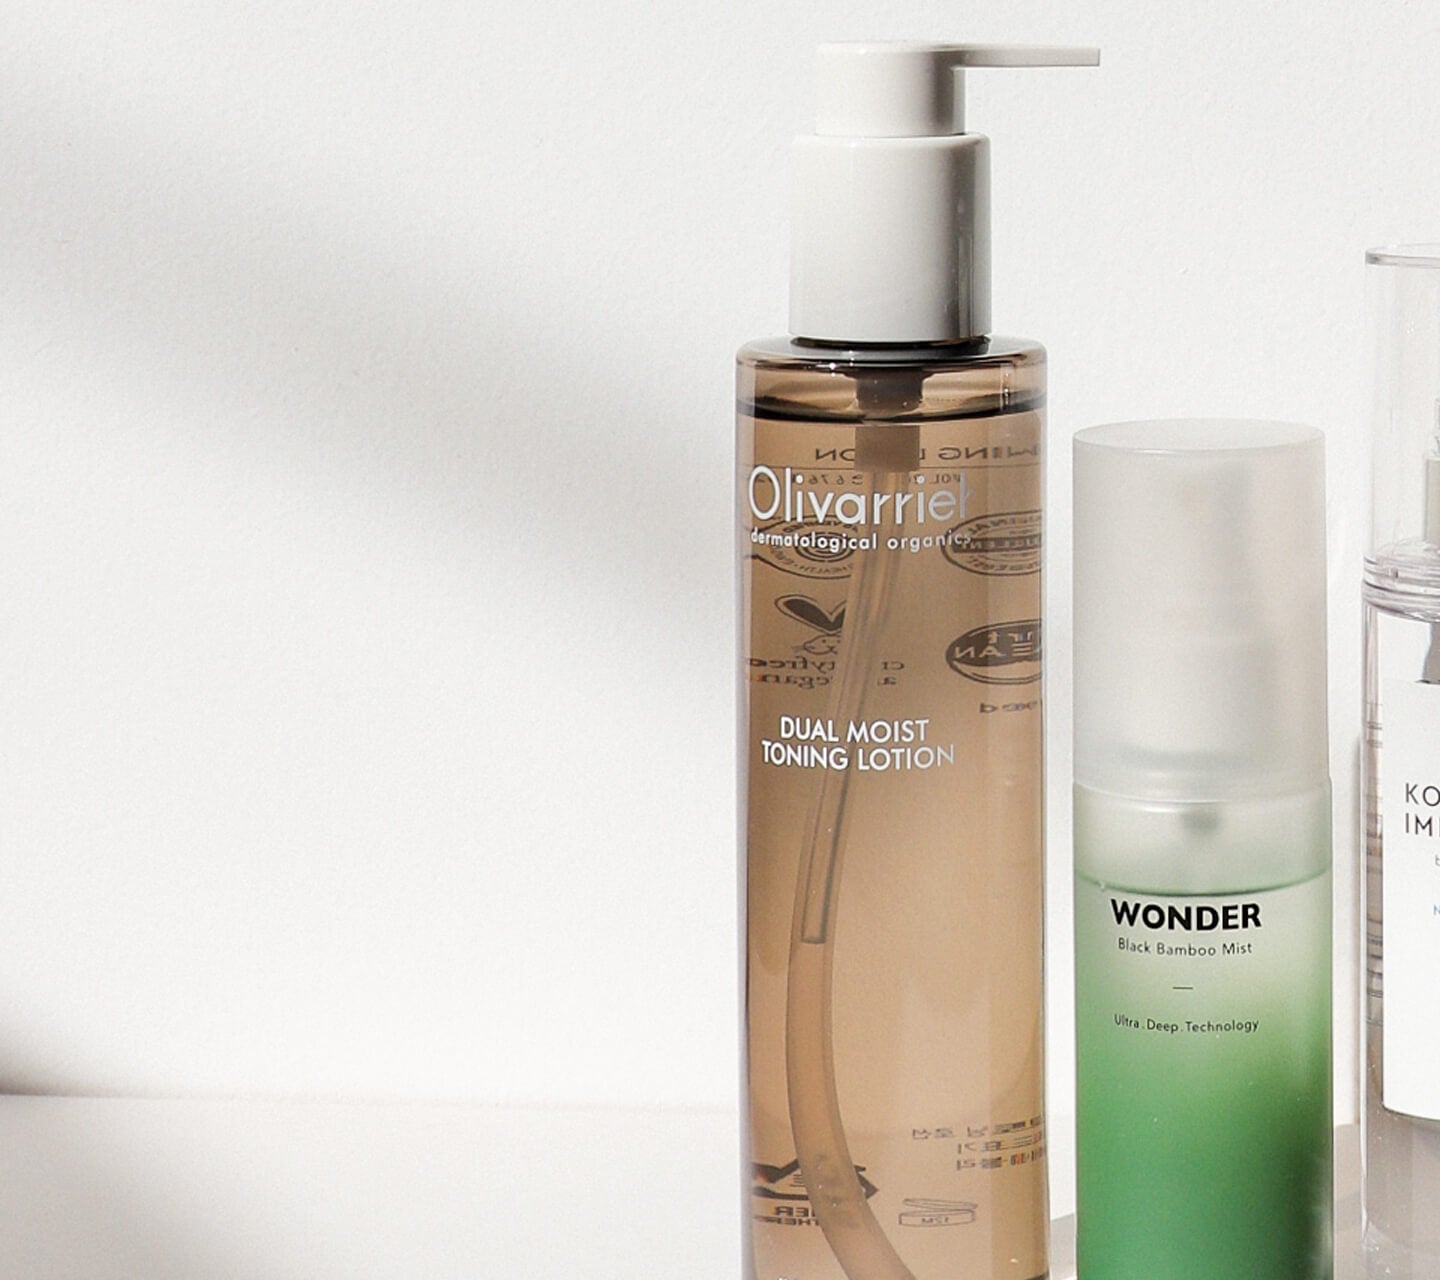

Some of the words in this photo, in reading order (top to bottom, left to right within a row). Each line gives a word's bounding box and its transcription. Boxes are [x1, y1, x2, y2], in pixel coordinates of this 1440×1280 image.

[749, 465, 973, 525] Olivarrier
[750, 529, 877, 553] dermatological
[887, 530, 972, 553] organics
[780, 716, 840, 743] DUAL
[846, 719, 930, 744] MOIST
[762, 740, 849, 770] TONING
[858, 744, 955, 771] LOTION
[1110, 898, 1262, 931] WONDER
[1118, 937, 1151, 954] Black
[1156, 942, 1217, 957] Bamboo
[1222, 942, 1253, 955] Mist
